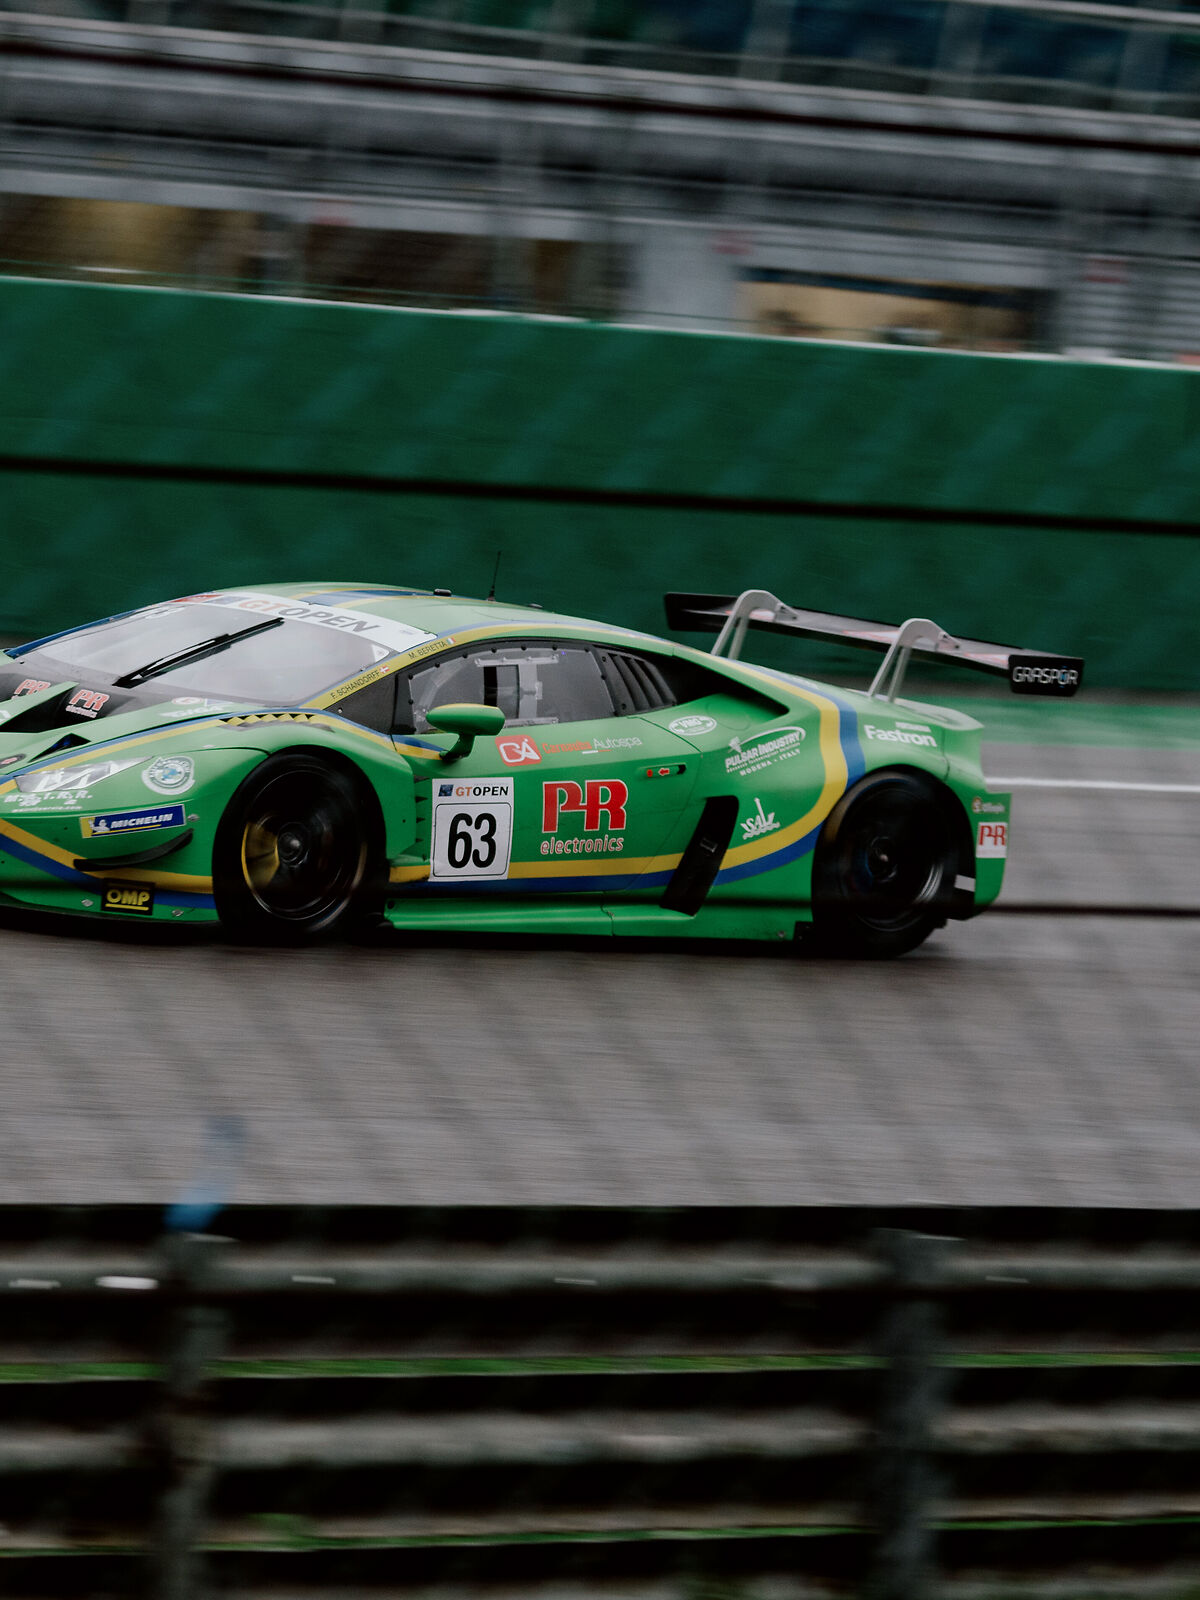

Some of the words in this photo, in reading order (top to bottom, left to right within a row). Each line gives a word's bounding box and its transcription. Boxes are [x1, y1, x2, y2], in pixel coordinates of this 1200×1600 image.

[417, 640, 447, 658] BERETTA
[337, 670, 381, 697] SCHANDORFF
[69, 689, 109, 711] PR
[593, 736, 643, 750] Autospa
[864, 725, 938, 748] Fastron
[725, 747, 759, 769] PULSAR
[757, 731, 801, 756] INDUSTRY
[739, 760, 773, 776] MODENA
[779, 748, 801, 761] ITALY
[541, 778, 629, 833] PR
[111, 813, 173, 829] MICHELIN
[447, 813, 497, 869] 63
[540, 835, 625, 855] electronics
[978, 825, 1007, 846] PR
[106, 888, 150, 906] OMP
